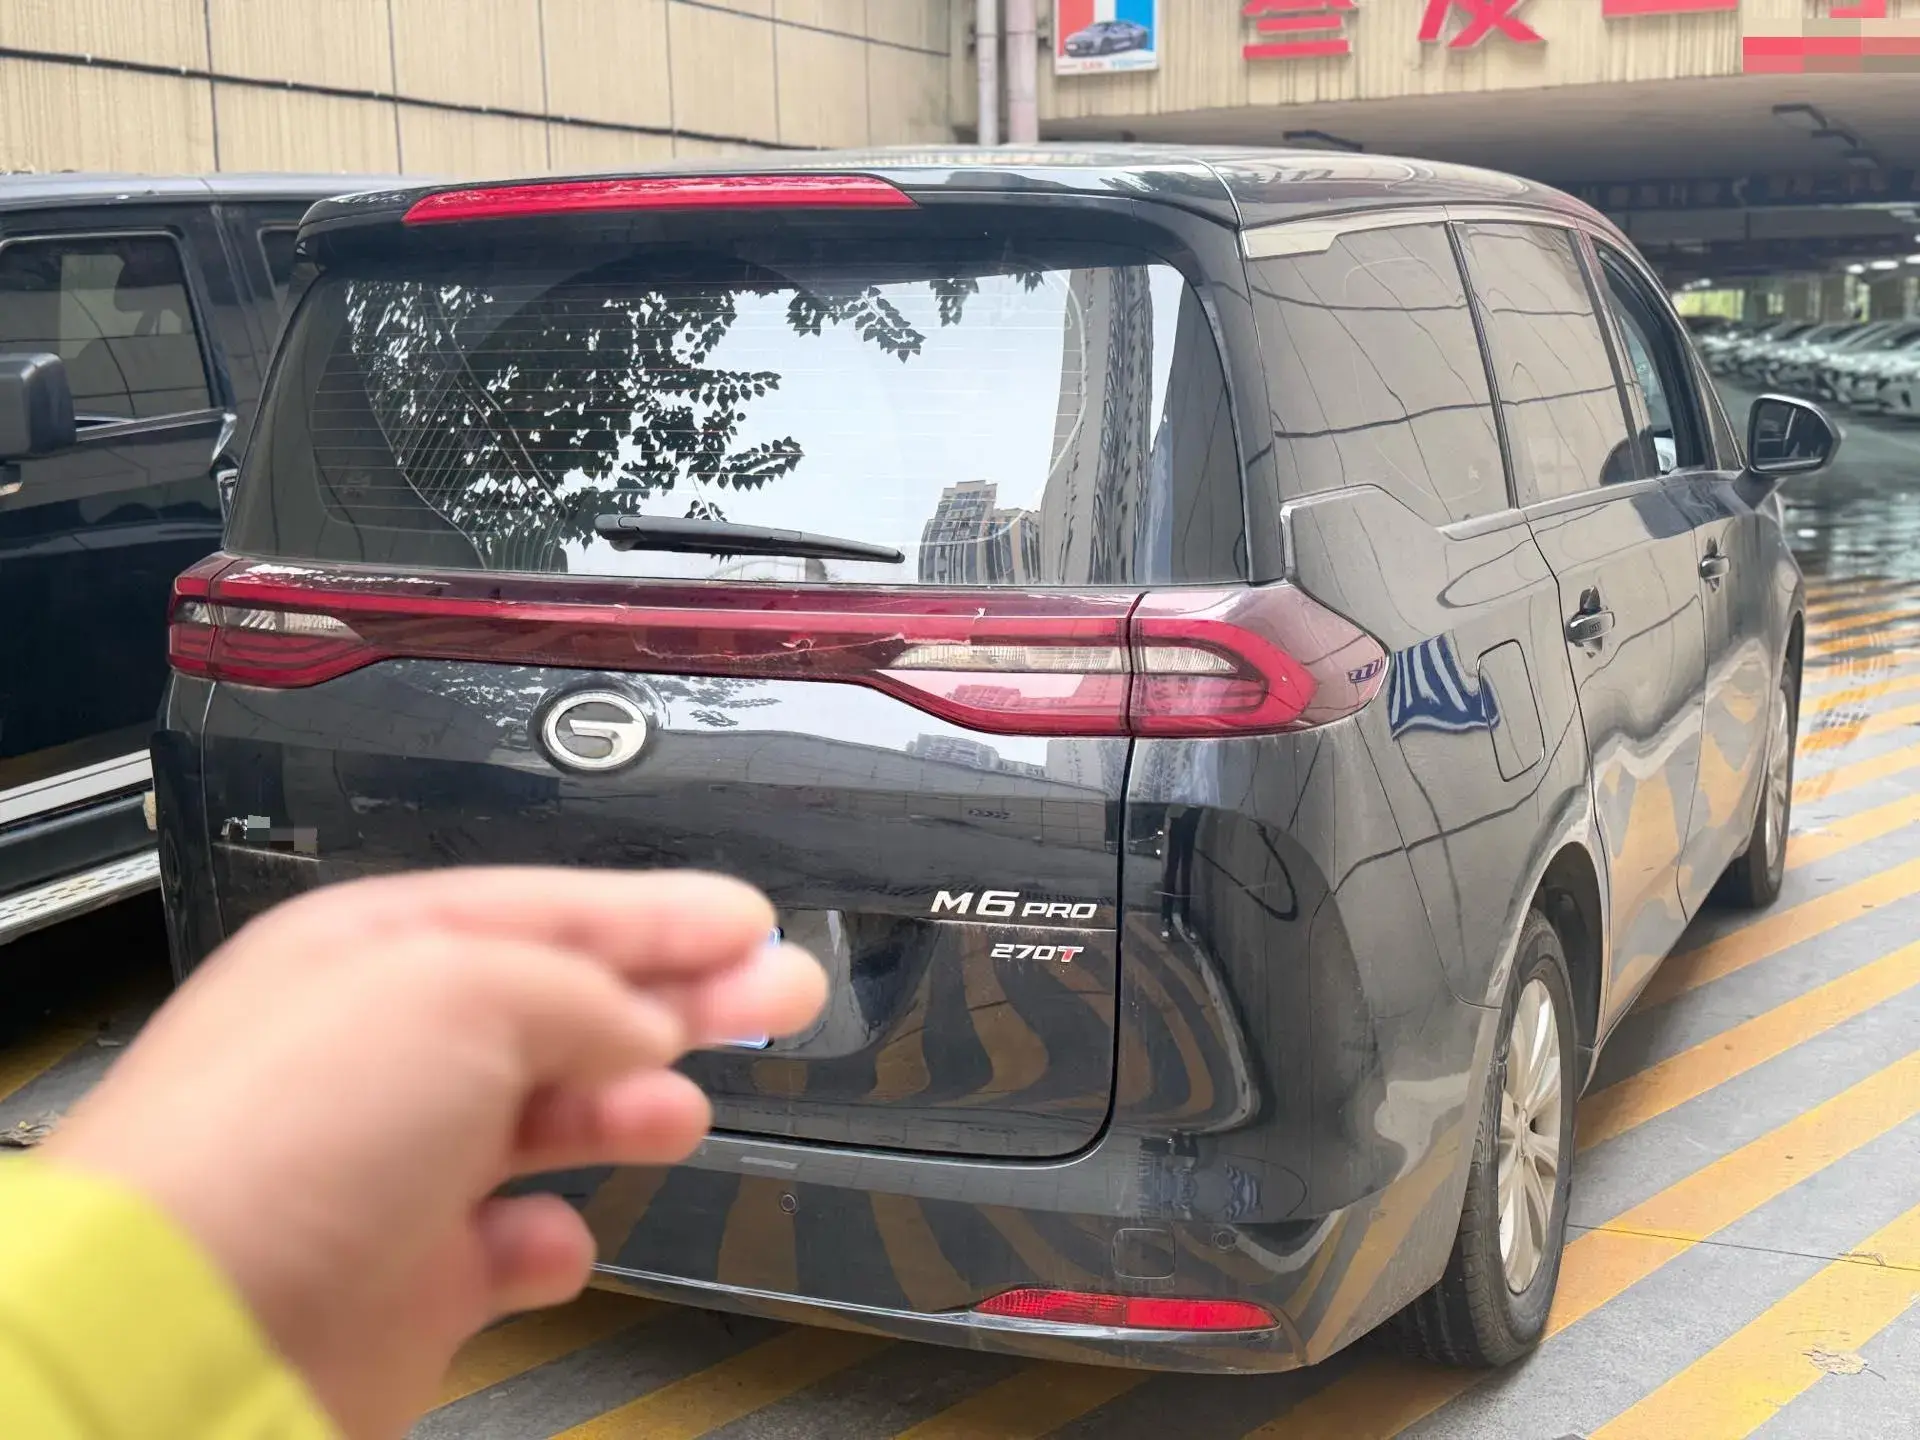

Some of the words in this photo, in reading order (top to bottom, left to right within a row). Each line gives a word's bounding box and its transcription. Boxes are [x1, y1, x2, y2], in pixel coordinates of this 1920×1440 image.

[930, 890, 1020, 917] M6
[1021, 902, 1098, 919] PRO
[990, 943, 1084, 963] 270T
